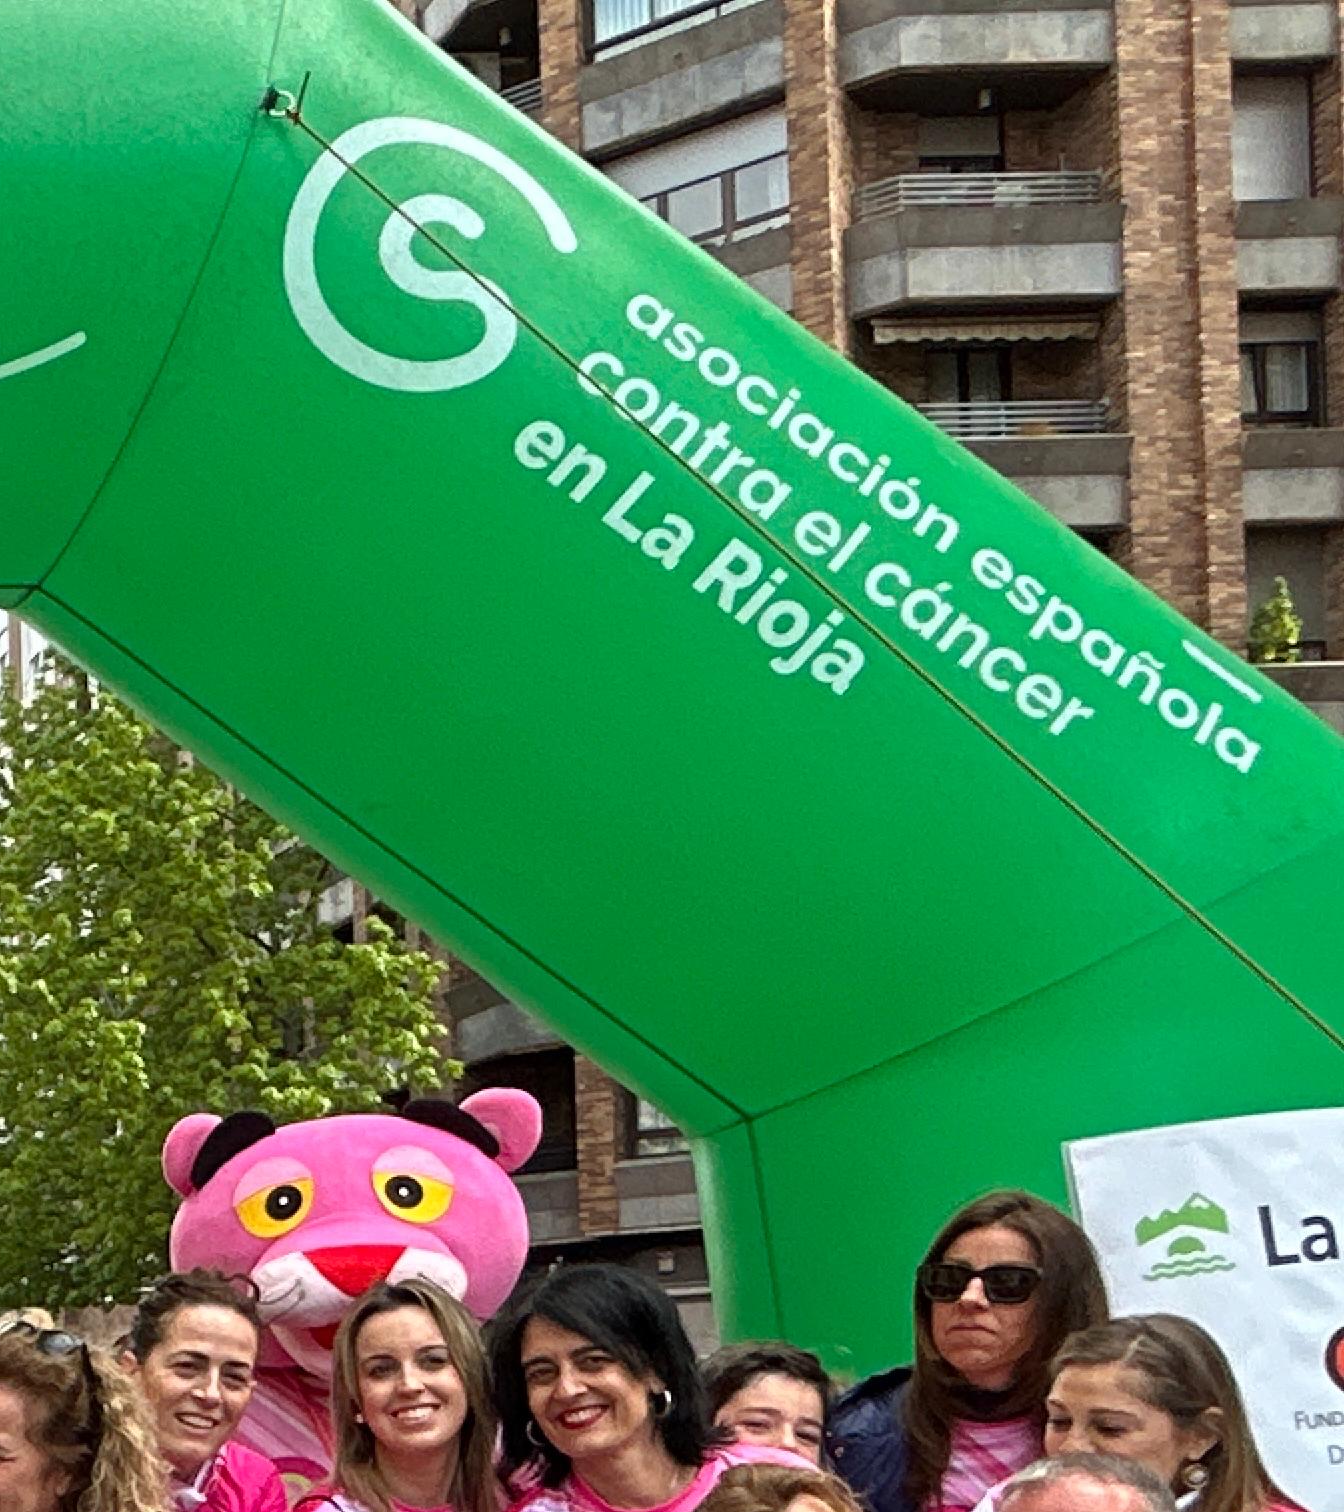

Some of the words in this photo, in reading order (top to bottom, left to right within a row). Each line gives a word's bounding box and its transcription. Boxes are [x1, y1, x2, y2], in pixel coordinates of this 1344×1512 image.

[512, 420, 609, 504] en
[601, 471, 697, 570] La
[693, 538, 867, 696] Rioja
[576, 351, 794, 521] contra
[794, 508, 869, 573] el
[864, 563, 1095, 737] cáncer
[627, 293, 959, 555] asociación
[971, 548, 1263, 774] española
[1257, 1205, 1340, 1267] La
